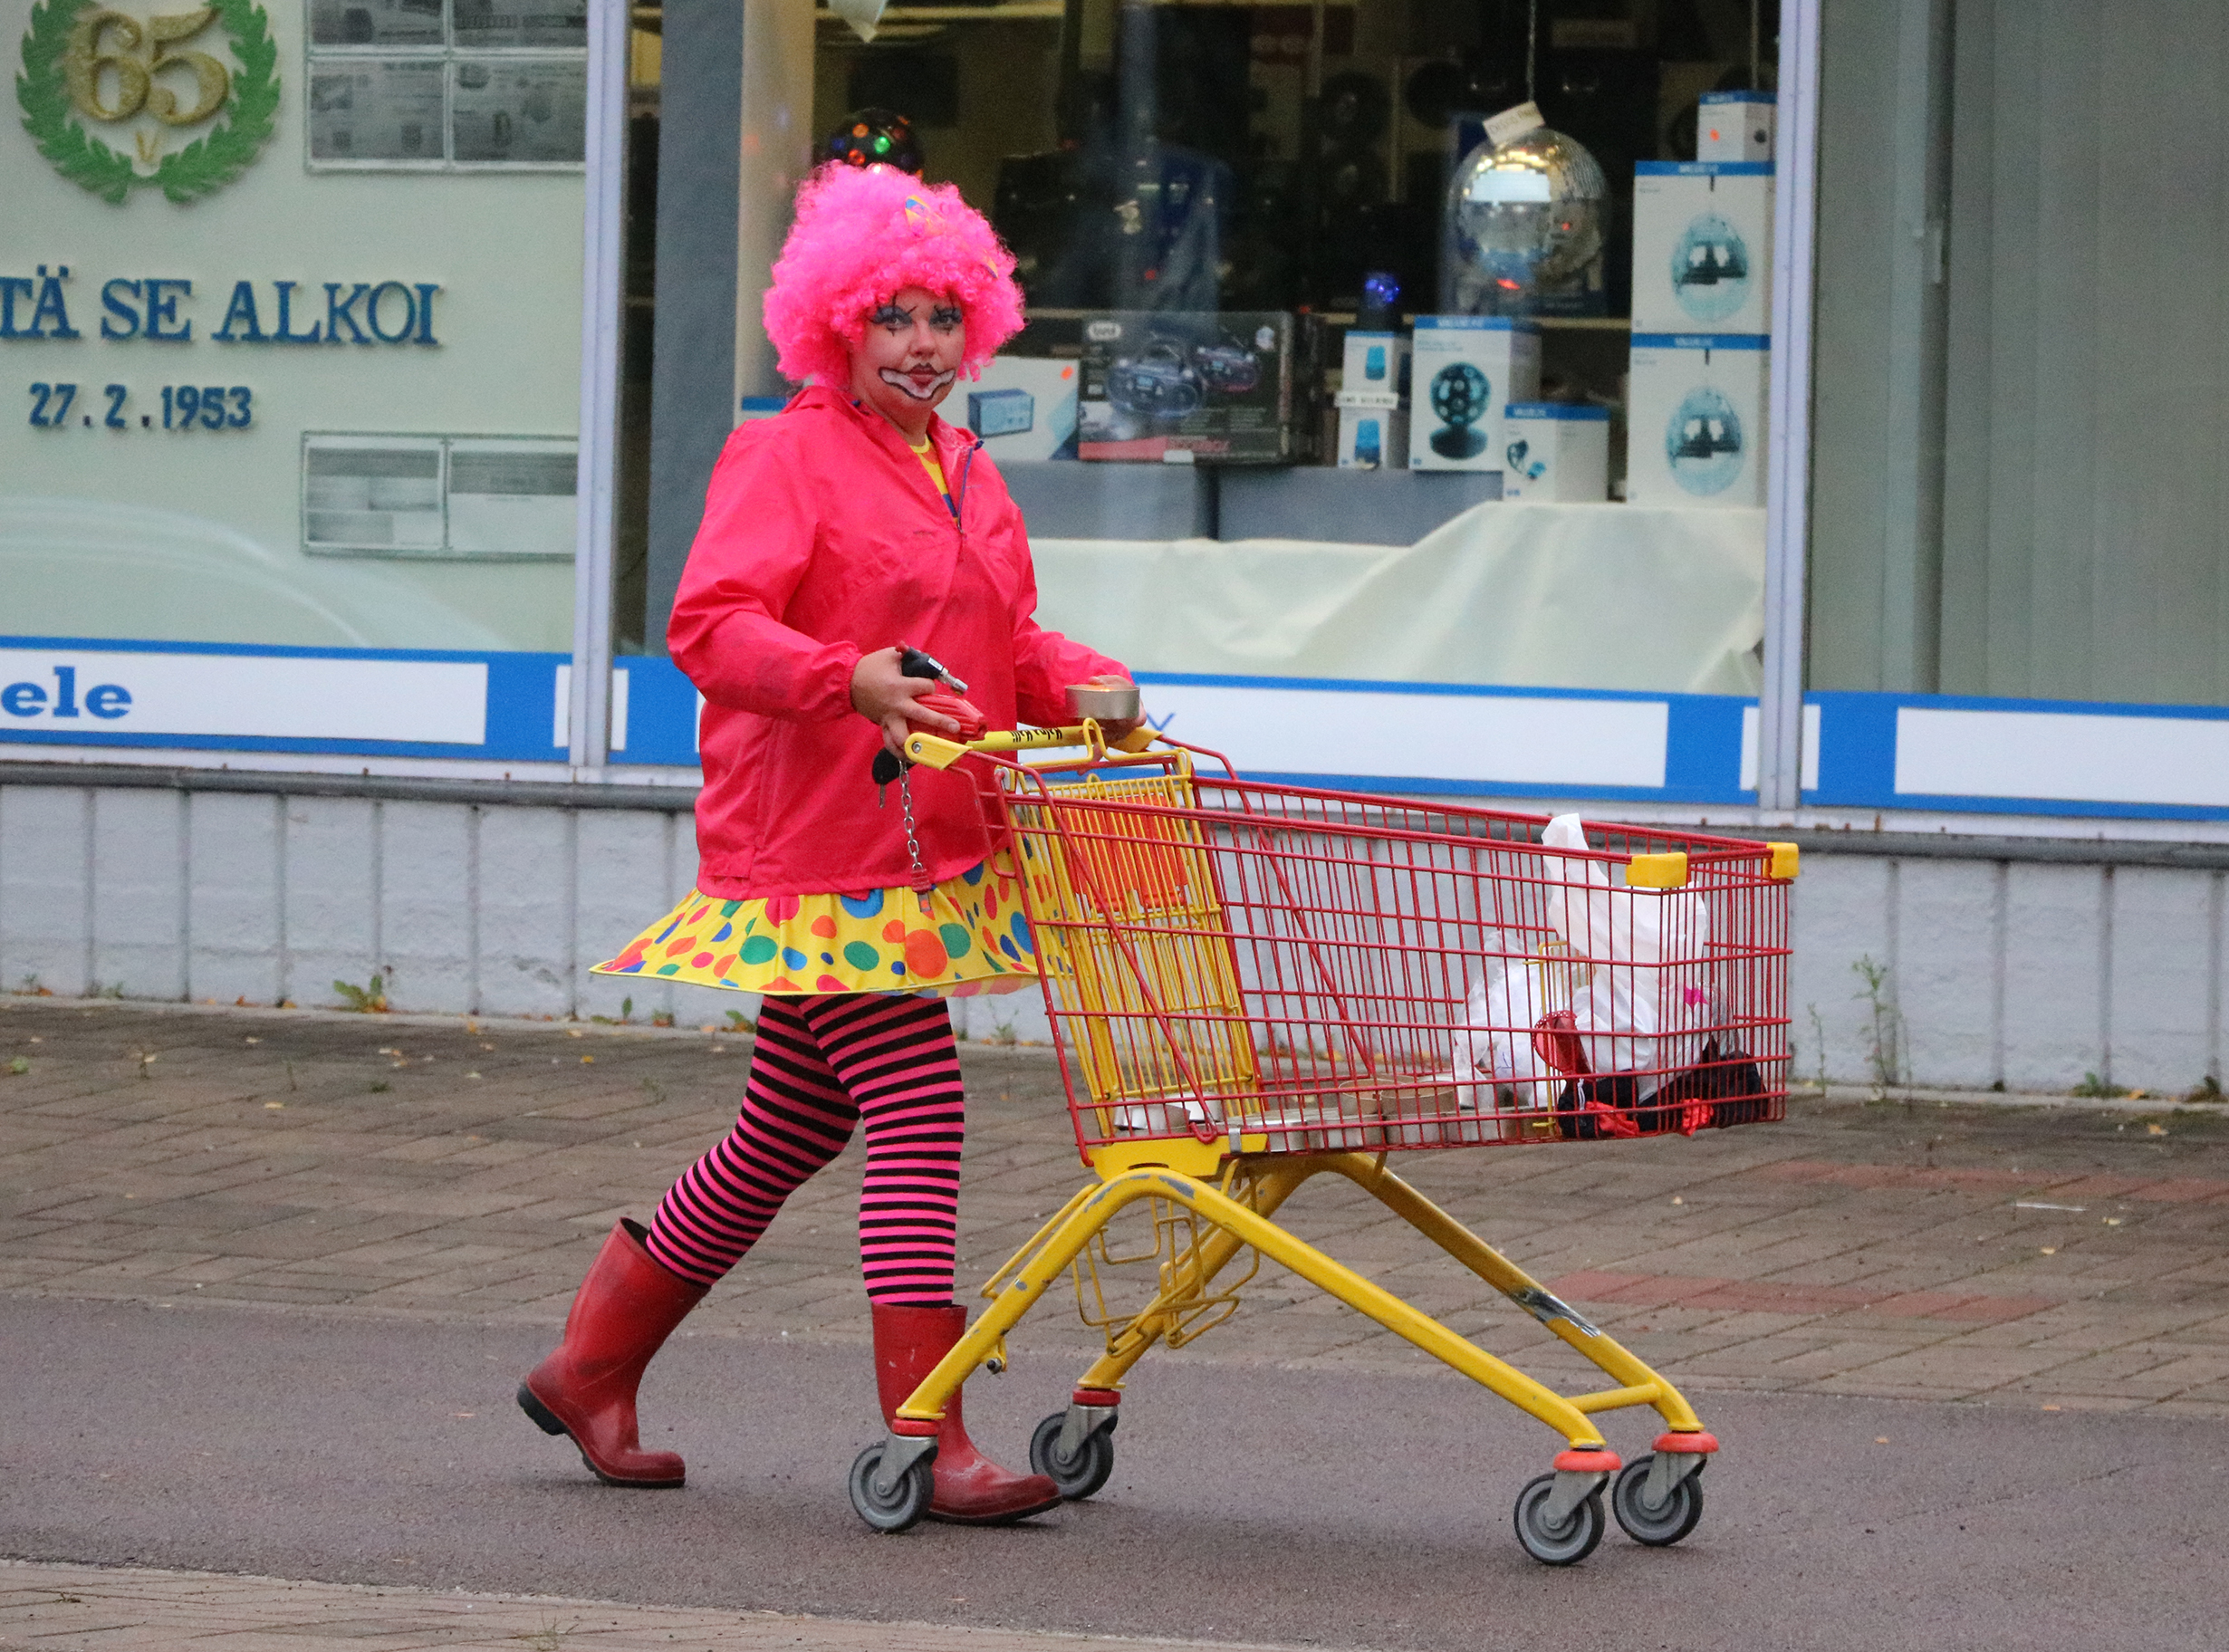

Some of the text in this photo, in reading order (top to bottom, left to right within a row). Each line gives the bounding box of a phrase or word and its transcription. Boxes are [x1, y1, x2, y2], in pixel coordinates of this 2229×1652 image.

[65, 5, 228, 125] 65
[101, 278, 192, 342] SE
[212, 281, 440, 346] ALKOI
[0, 665, 133, 721] ele
